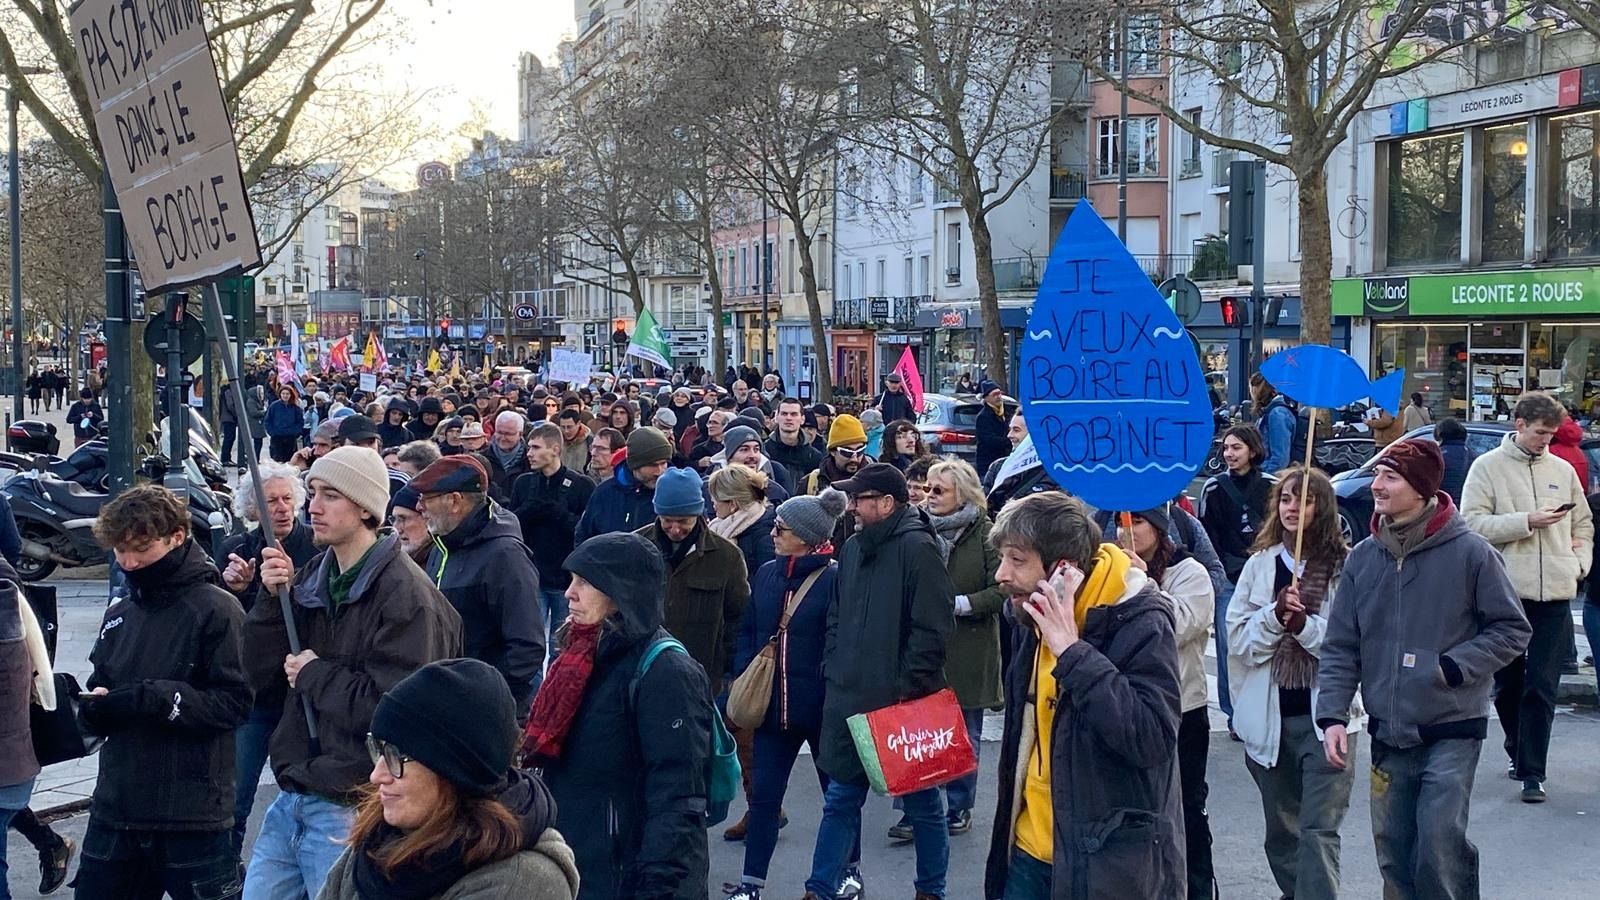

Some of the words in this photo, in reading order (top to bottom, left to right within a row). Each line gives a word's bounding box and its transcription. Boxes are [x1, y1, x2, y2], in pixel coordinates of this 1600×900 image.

[1460, 98, 1492, 113] LECONTE
[1493, 97, 1498, 108] 2
[1499, 93, 1523, 107] ROUES
[115, 95, 169, 174] DANS
[164, 80, 196, 145] LE
[146, 175, 236, 270] BOCAGE
[1059, 259, 1113, 294] JE
[1452, 284, 1516, 304] LECONTE
[1519, 284, 1528, 302] 2
[1532, 282, 1583, 302] ROUES
[1052, 310, 1156, 354] VEUX
[1143, 358, 1190, 401] AU
